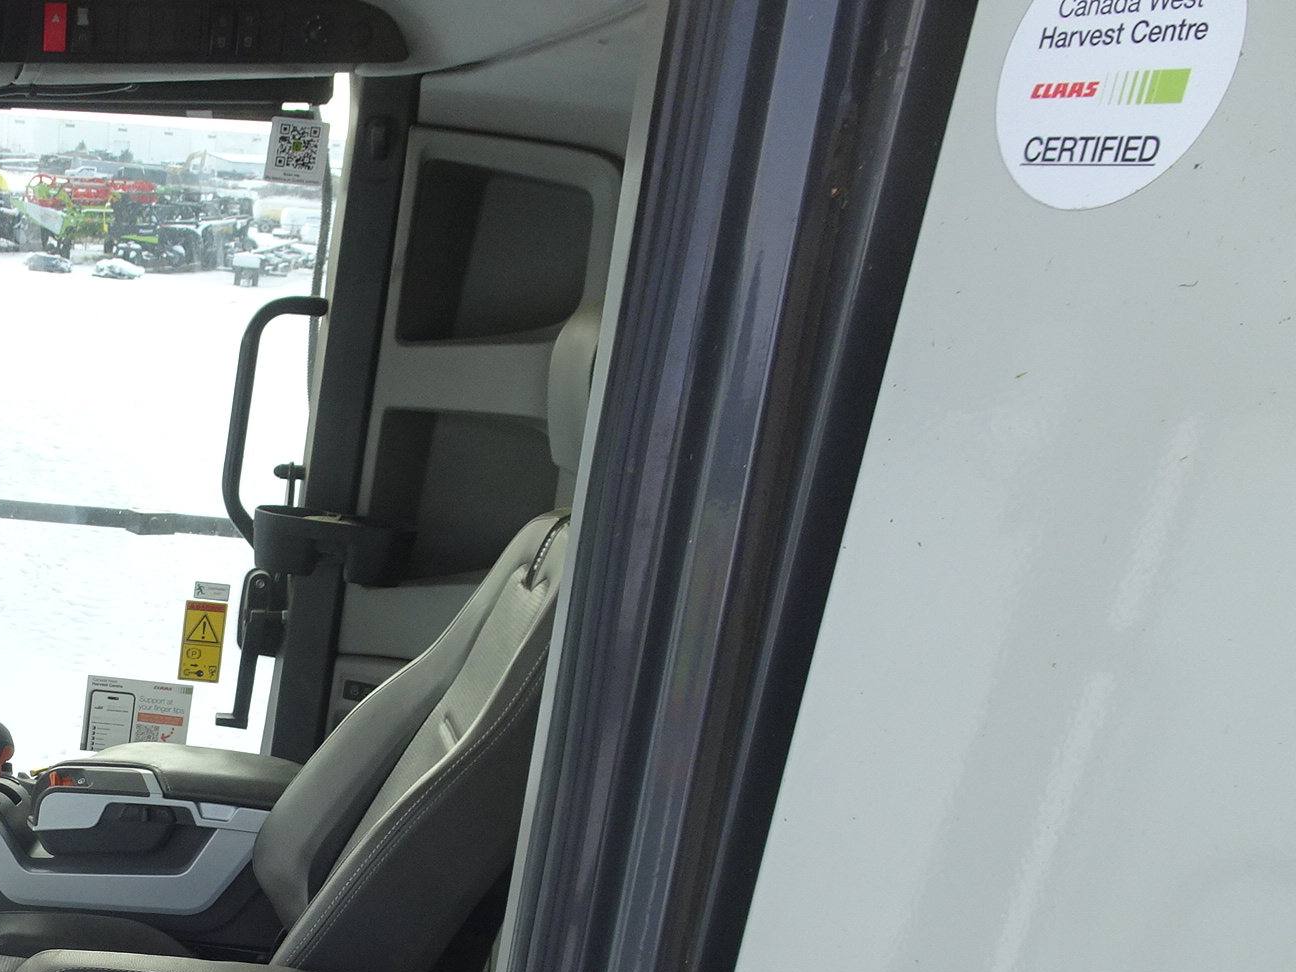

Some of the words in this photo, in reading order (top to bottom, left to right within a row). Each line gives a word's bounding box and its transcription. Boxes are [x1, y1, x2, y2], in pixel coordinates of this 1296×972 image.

[1059, 0, 1140, 18] Canada
[1038, 23, 1125, 49] Harvest
[1131, 19, 1209, 43] Centre
[1030, 81, 1100, 99] CLAAS
[1024, 135, 1160, 163] CERTIFIED
[139, 695, 165, 705] Support
[154, 705, 172, 713] finger
